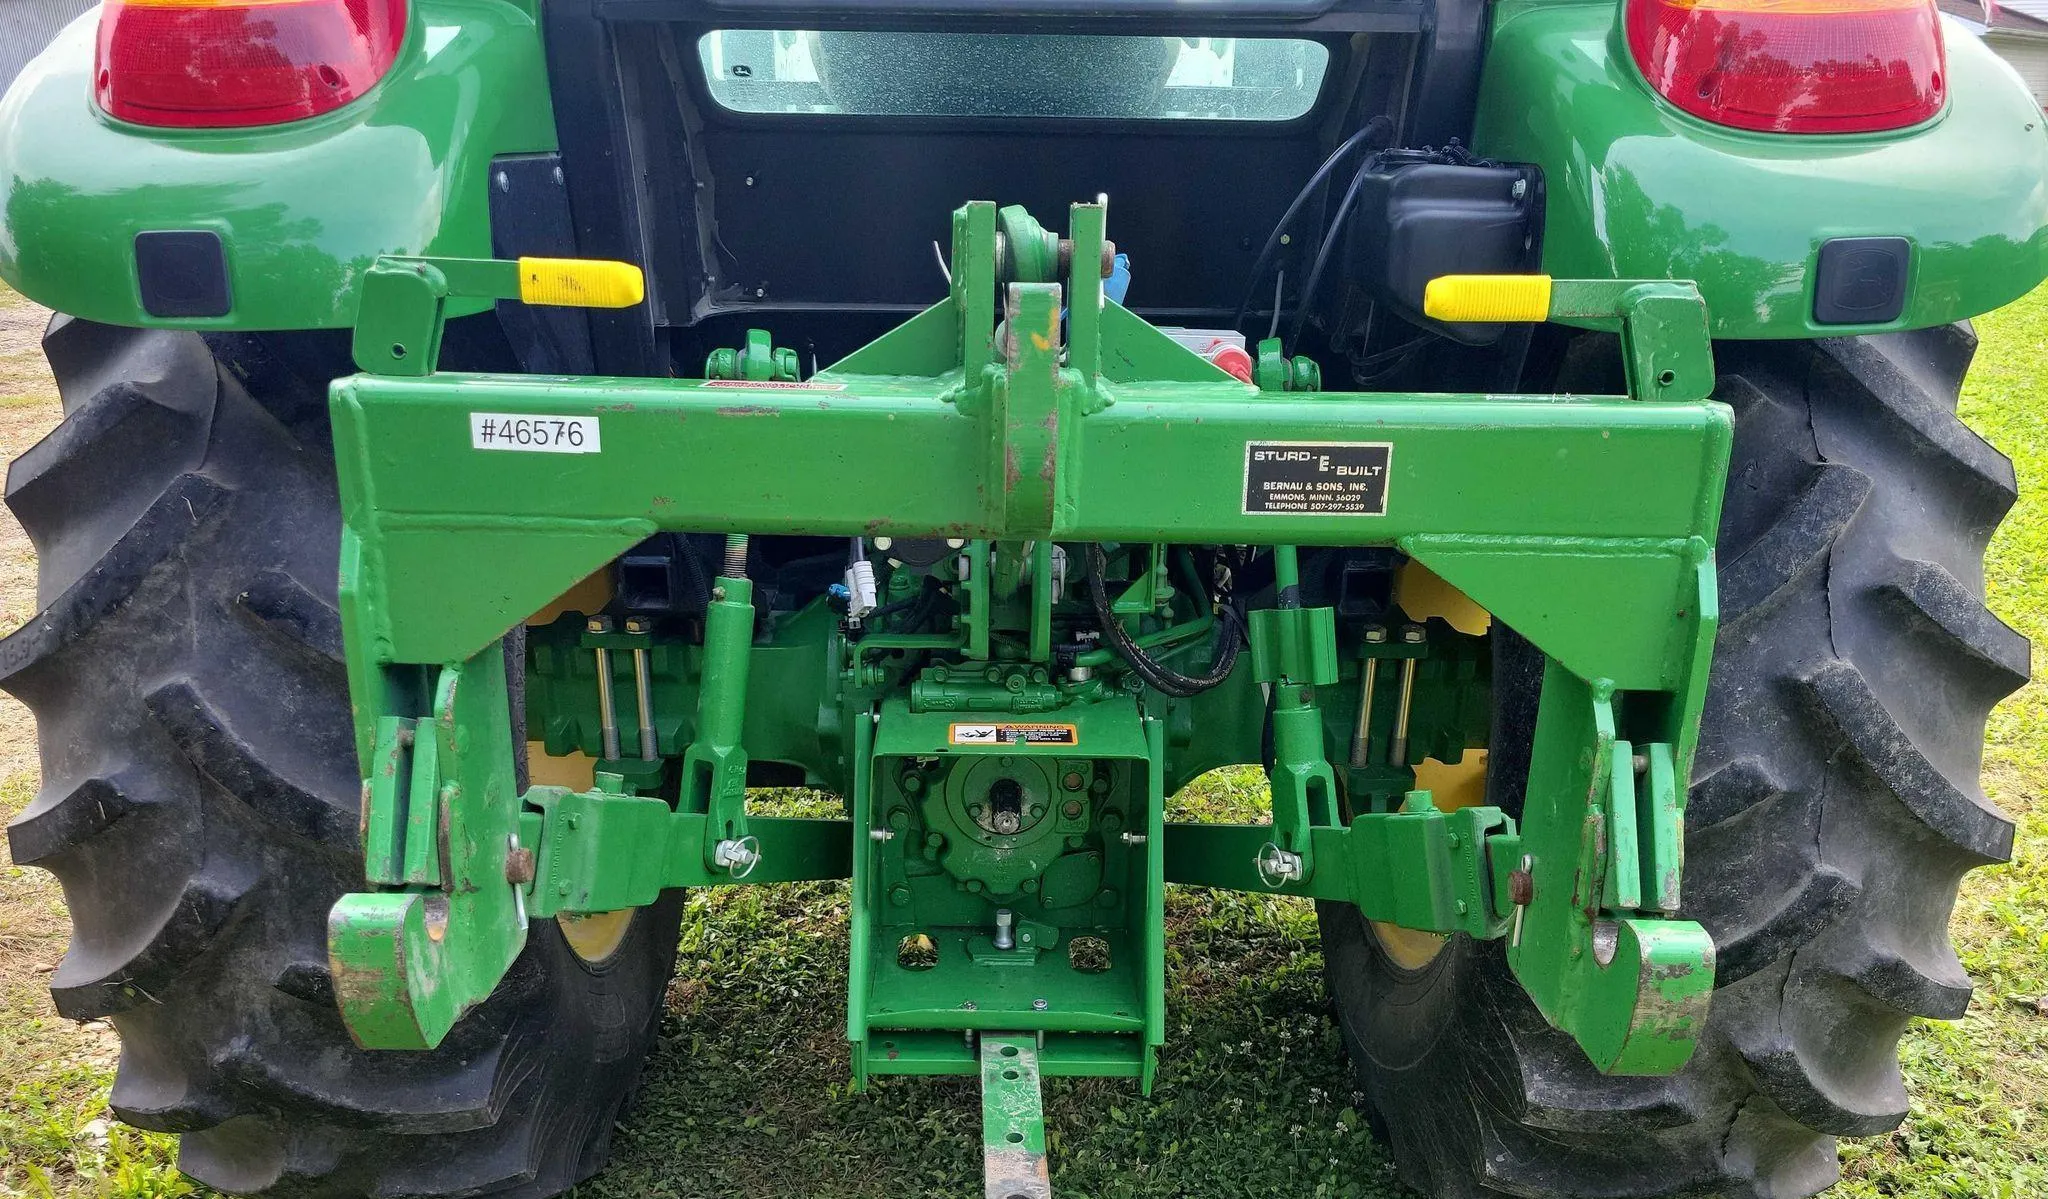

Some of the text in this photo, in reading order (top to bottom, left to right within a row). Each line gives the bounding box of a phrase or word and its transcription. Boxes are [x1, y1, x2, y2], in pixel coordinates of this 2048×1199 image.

[481, 419, 584, 446] #46576
[1263, 481, 1303, 491] BERNAU
[1305, 482, 1313, 490] &
[1316, 482, 1346, 492] SONS,
[1269, 493, 1307, 501] EMMONS,
[1265, 502, 1365, 511] TELEPHONE 507-297-5539
